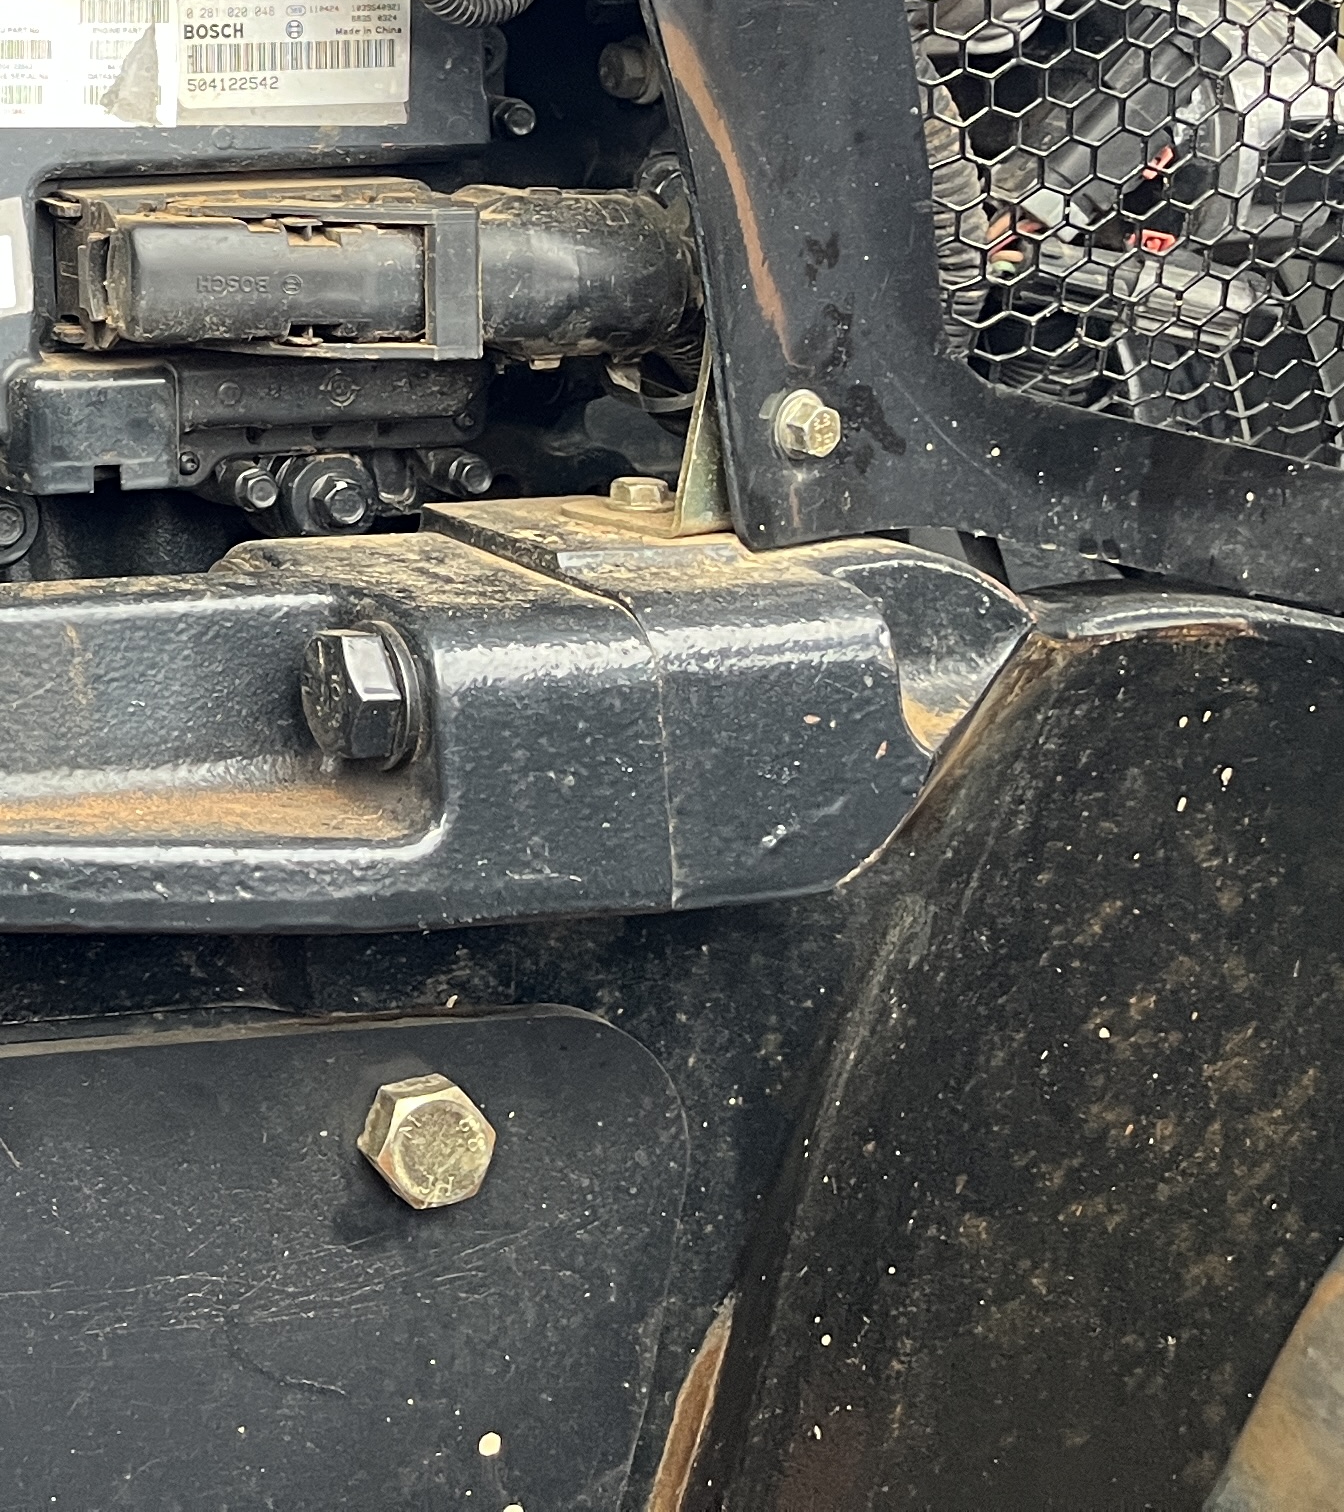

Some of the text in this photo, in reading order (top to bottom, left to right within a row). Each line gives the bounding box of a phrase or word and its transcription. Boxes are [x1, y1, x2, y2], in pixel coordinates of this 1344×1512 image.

[200, 8, 219, 18] 281
[183, 23, 244, 40] BOSCH
[335, 27, 361, 35] Made
[375, 25, 402, 34] China
[187, 76, 280, 93] 504122542
[196, 275, 270, 293] BOSCH
